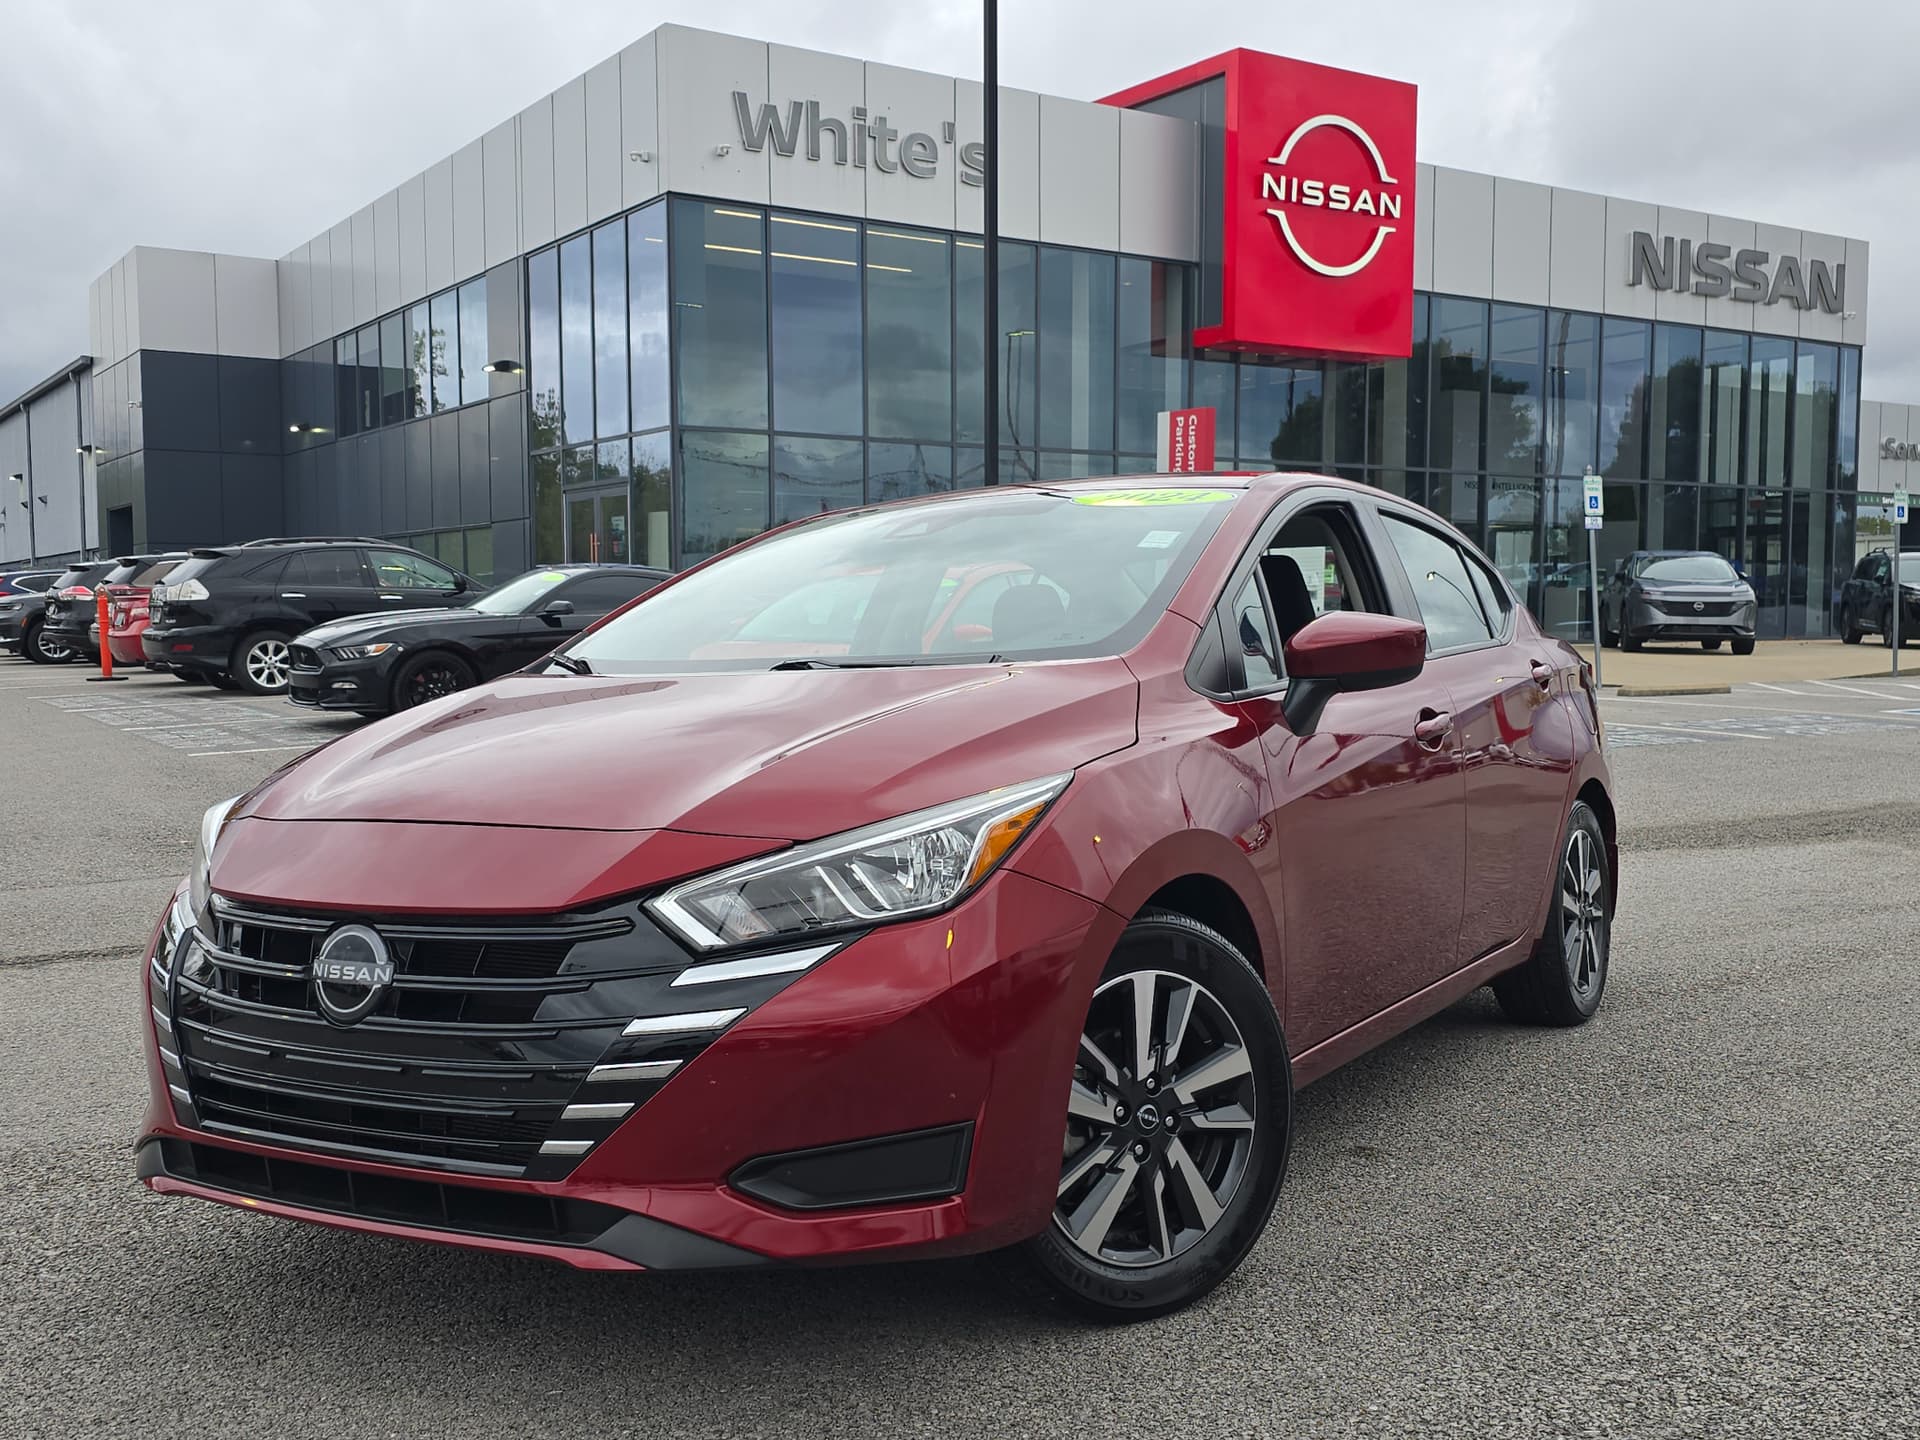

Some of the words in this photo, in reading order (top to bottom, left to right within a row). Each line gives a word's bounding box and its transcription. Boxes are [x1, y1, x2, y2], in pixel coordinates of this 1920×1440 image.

[732, 90, 985, 188] White's
[1262, 173, 1401, 219] NISSAN
[1629, 231, 1846, 314] NISSAN
[312, 960, 391, 982] NISSAN
